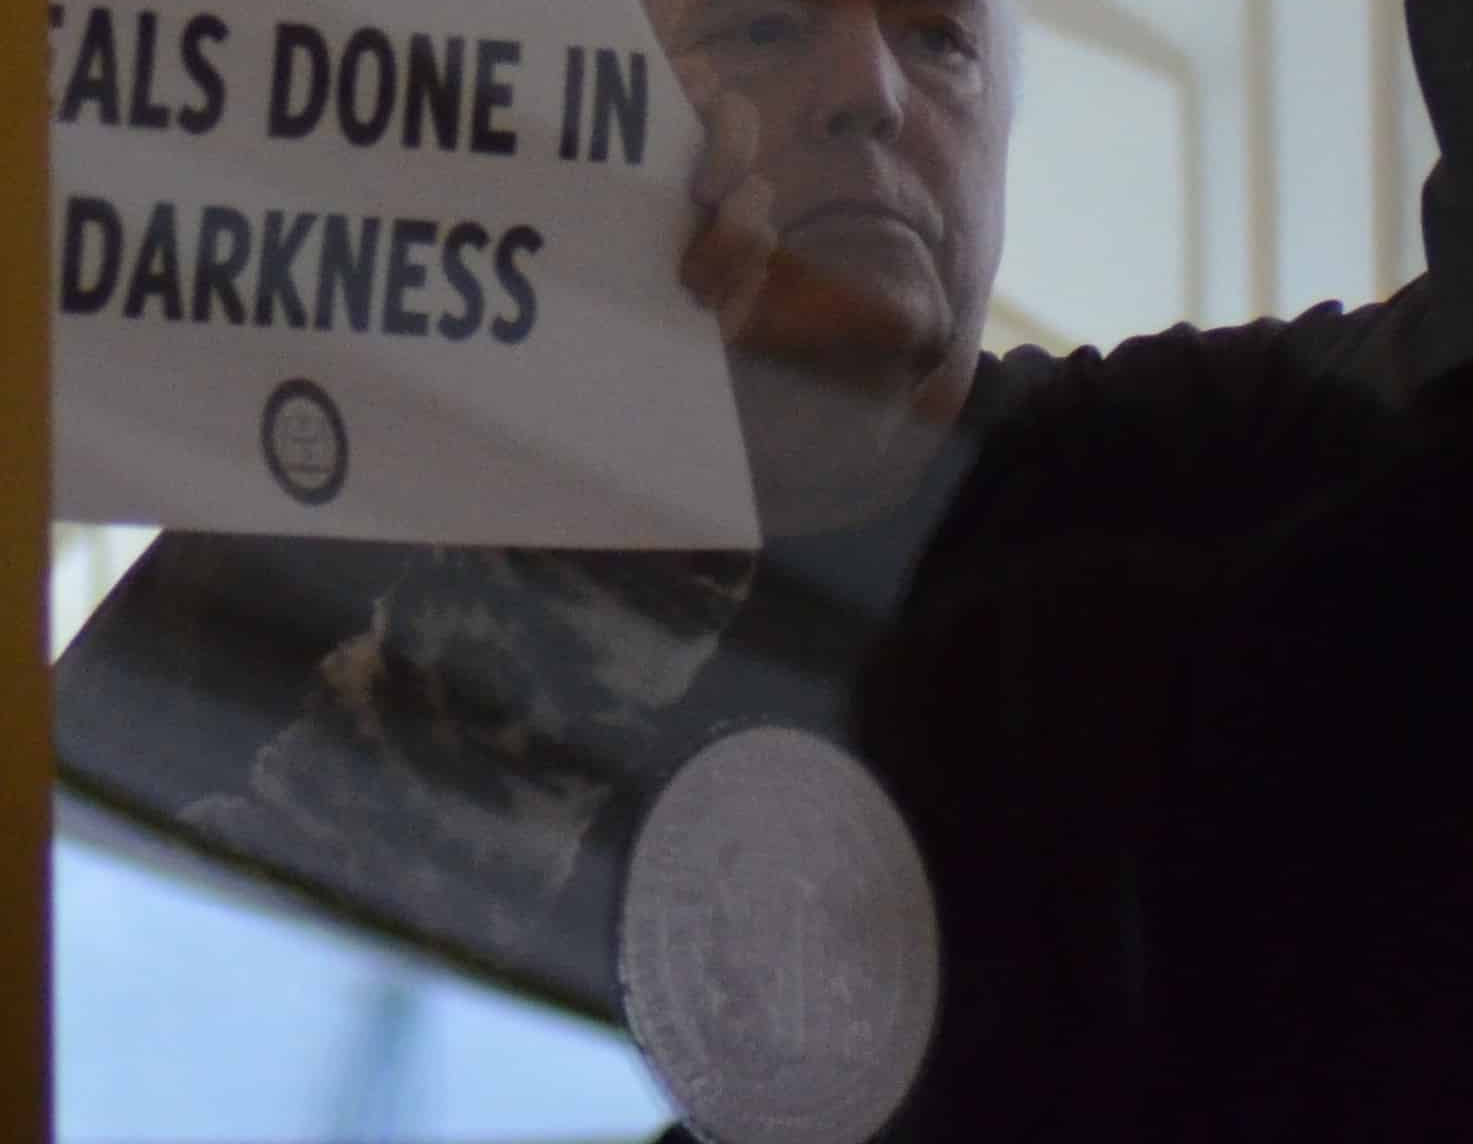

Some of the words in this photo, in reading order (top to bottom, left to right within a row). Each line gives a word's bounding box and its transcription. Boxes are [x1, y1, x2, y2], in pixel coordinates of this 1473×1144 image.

[46, 4, 230, 135] ALS
[266, 20, 522, 156] DONE
[556, 44, 650, 166] IN
[58, 194, 546, 346] DARKNESS
